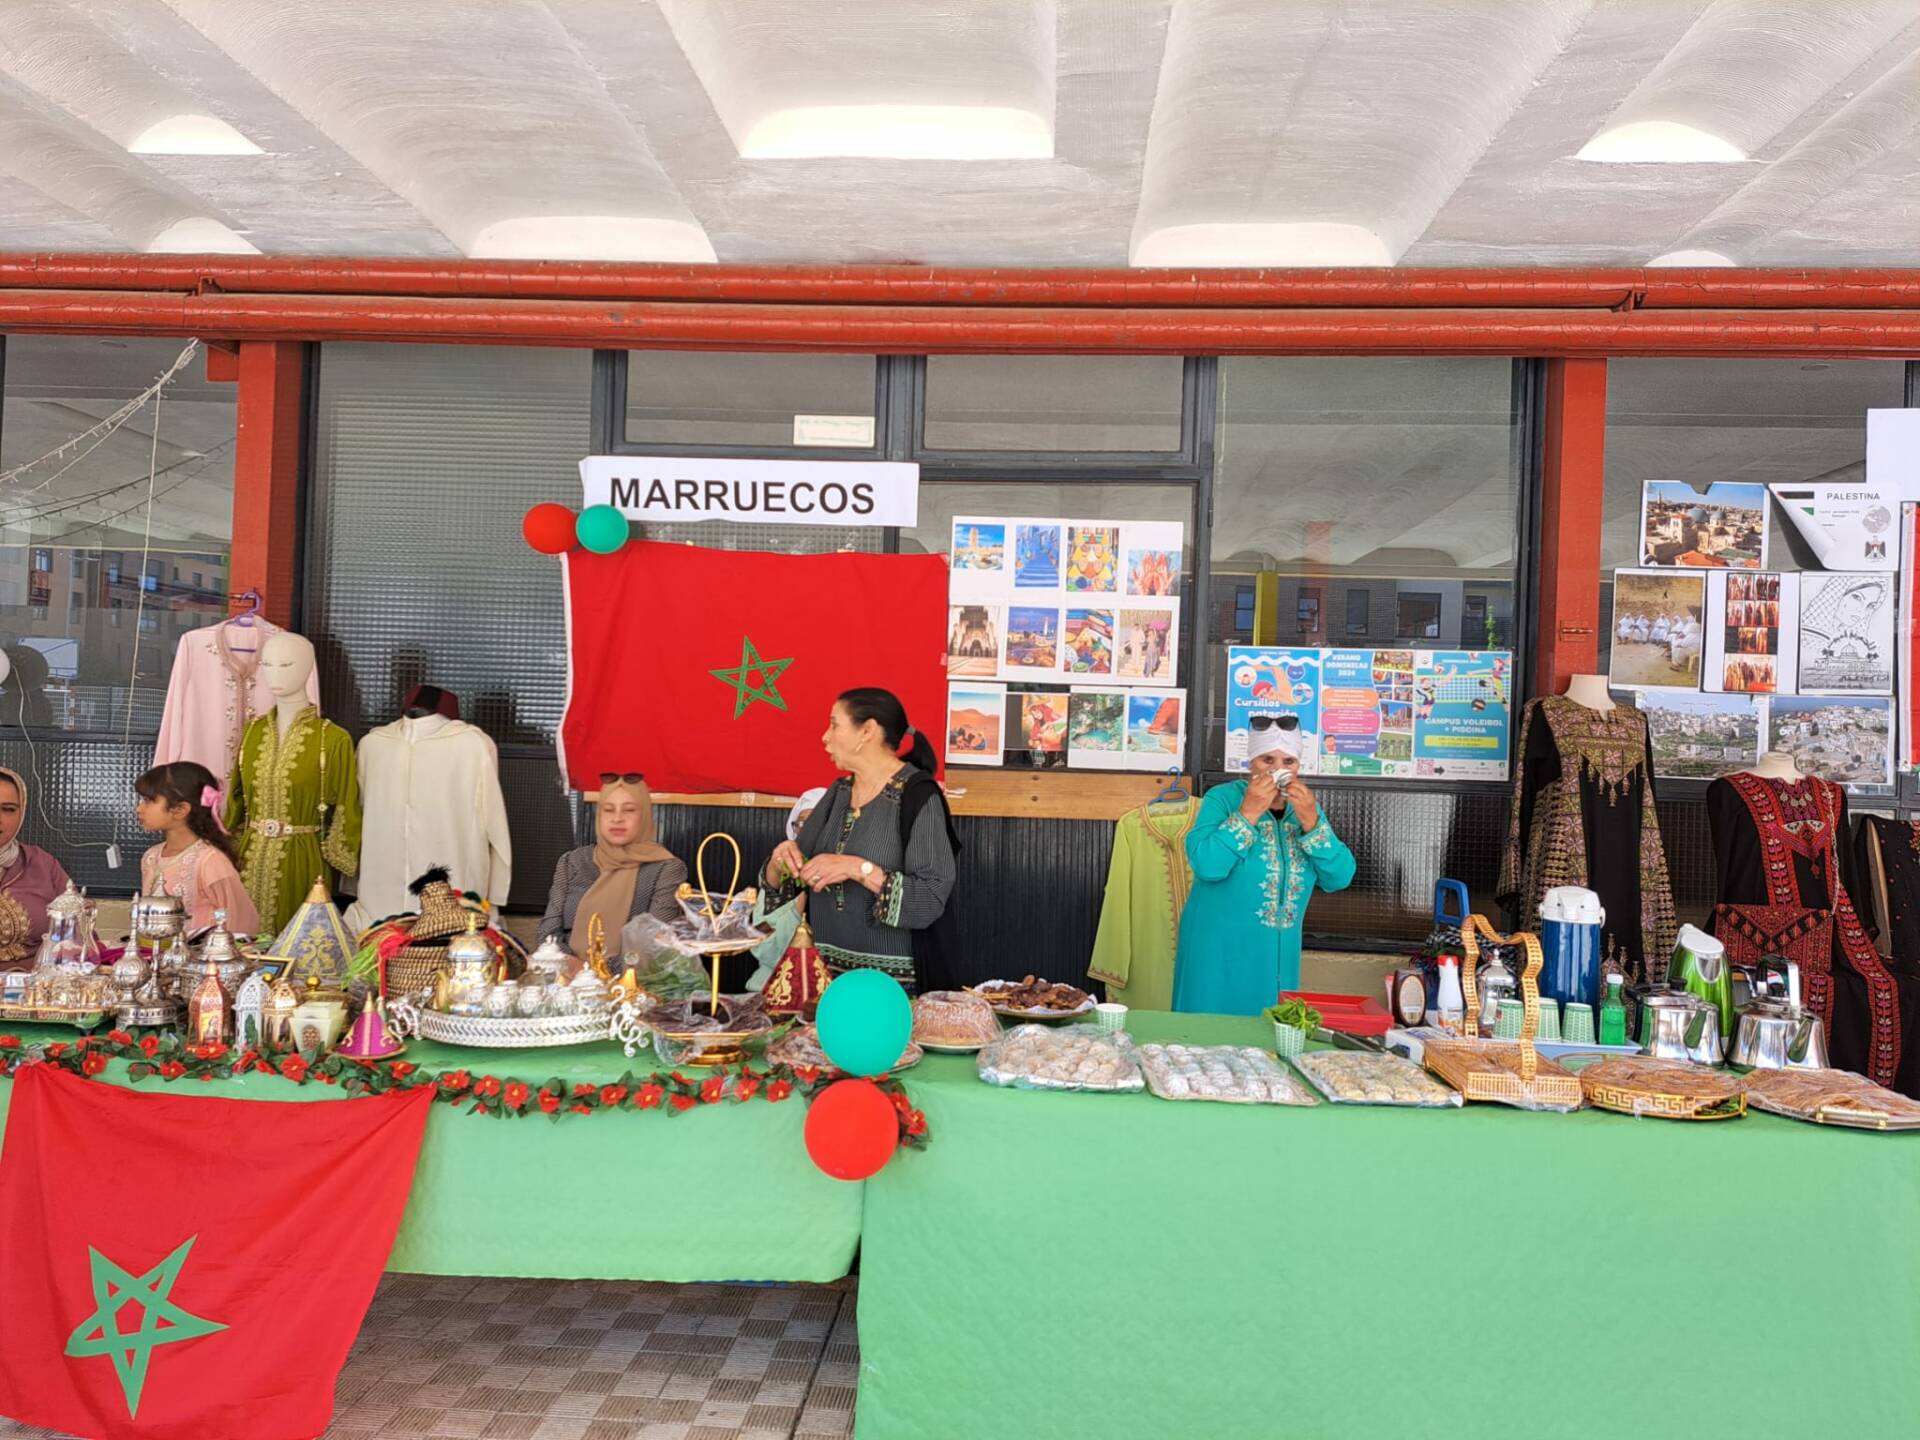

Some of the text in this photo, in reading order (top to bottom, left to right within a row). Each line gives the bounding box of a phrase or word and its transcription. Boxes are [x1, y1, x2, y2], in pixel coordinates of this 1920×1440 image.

[610, 477, 875, 515] MARRUECOS
[1826, 491, 1881, 501] PALESTINA
[1234, 697, 1281, 708] Cursillos
[1463, 718, 1504, 727] VOLEIBOL
[1451, 726, 1487, 734] PISCINA
